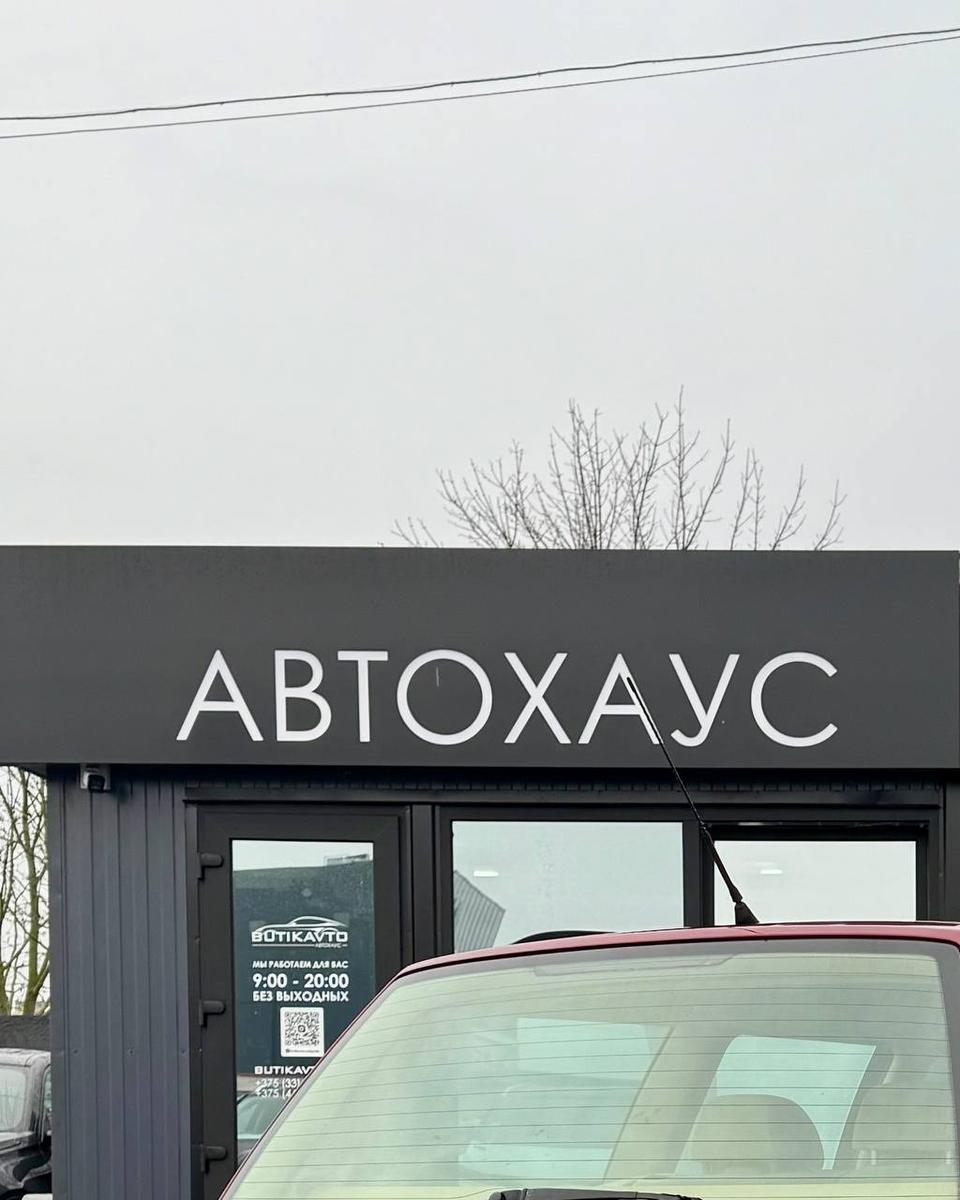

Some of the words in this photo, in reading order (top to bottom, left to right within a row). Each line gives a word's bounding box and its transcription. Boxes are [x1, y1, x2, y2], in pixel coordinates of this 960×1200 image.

[176, 649, 838, 746] АВТОХАУС
[251, 931, 348, 942] BUTIKAVTO
[252, 960, 268, 968] МЫ
[268, 960, 311, 968] РАБОТАЕМ
[312, 960, 330, 969] ДЛЯ
[331, 960, 349, 968] ВАС
[252, 973, 288, 988] 9:00
[304, 973, 349, 988] 20:00
[252, 991, 273, 1002] БЕЗ
[276, 990, 349, 1003] ВЫХОДНЫХ
